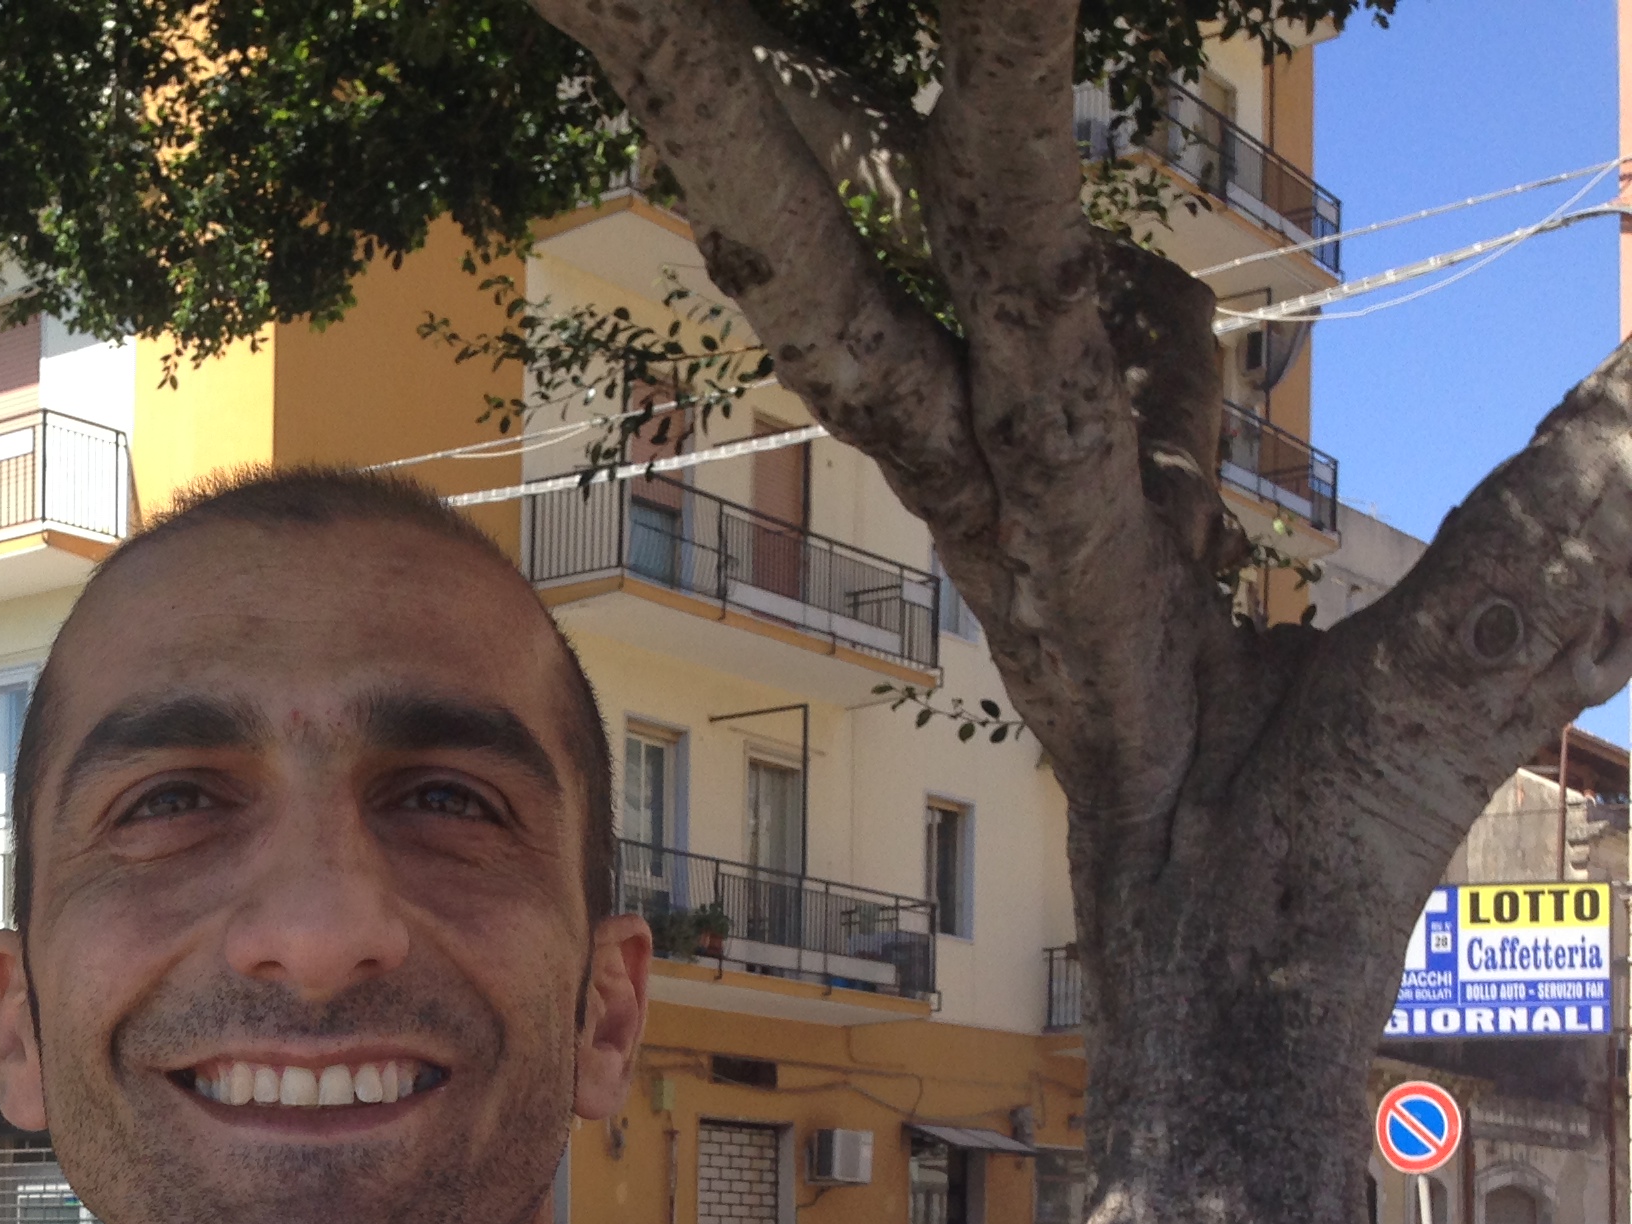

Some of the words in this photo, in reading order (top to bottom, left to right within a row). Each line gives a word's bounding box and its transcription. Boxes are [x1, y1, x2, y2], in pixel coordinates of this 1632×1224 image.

[1469, 888, 1600, 924] LOTTO
[1467, 934, 1603, 971] Caffetteria
[1466, 983, 1497, 1000] BOLLO
[1499, 983, 1526, 1000] AUTO
[1537, 982, 1583, 999] SERVIZIO
[1585, 981, 1604, 998] FAX
[1384, 1006, 1604, 1034] GIORNALI
